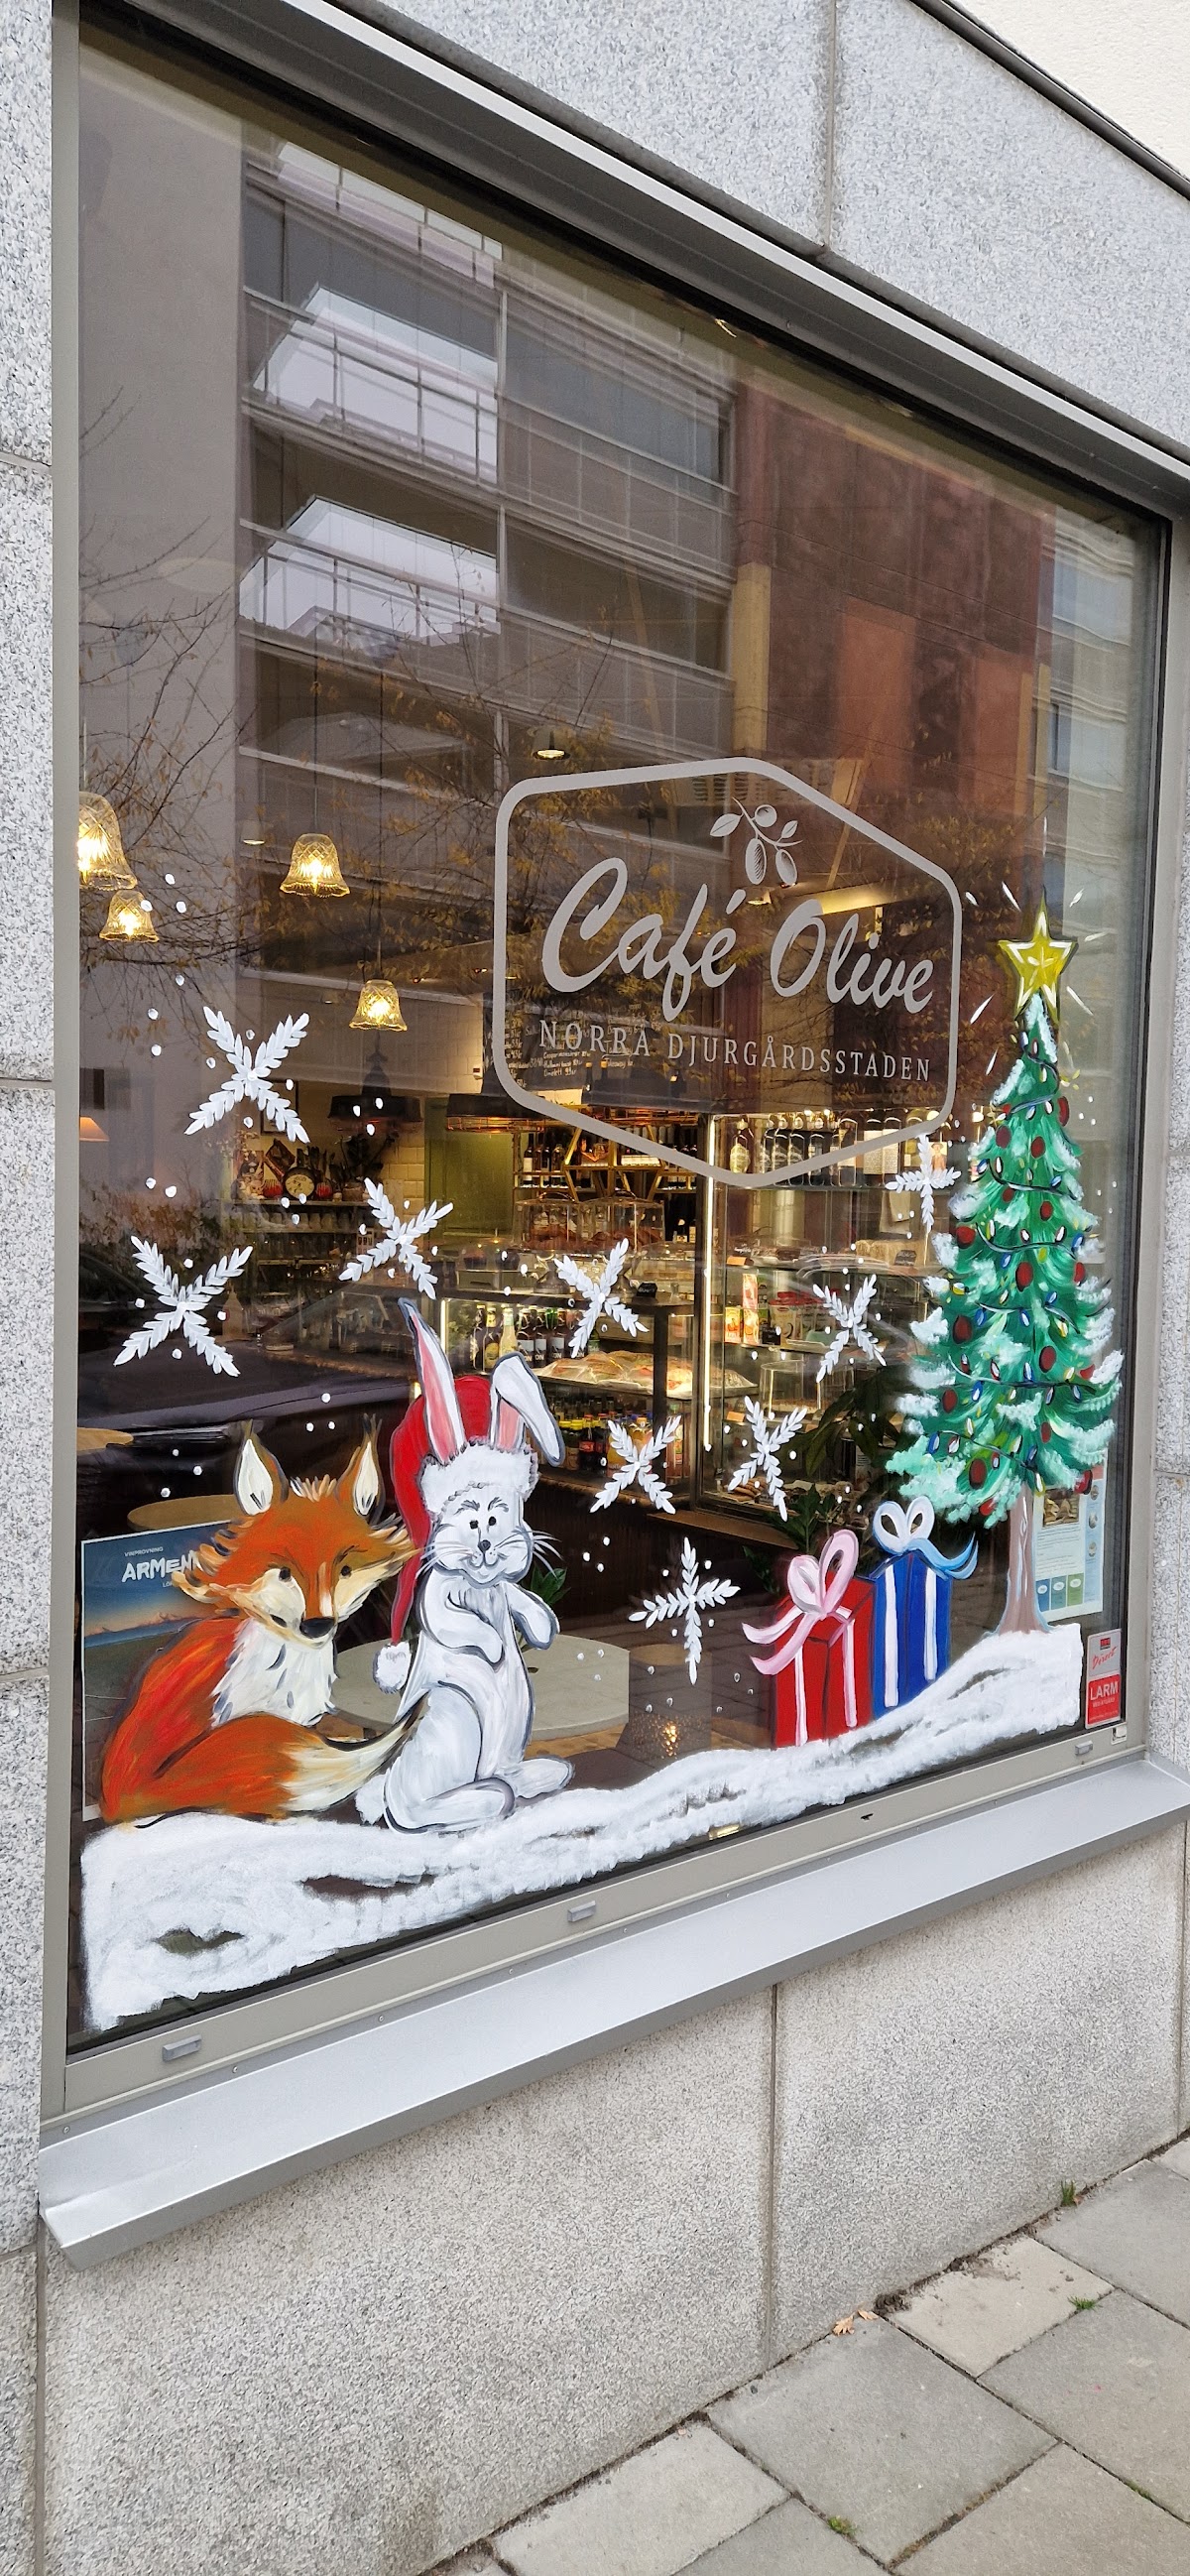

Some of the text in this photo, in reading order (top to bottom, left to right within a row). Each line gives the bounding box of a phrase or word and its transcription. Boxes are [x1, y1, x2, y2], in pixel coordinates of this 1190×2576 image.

[542, 858, 936, 1022] Café Olive
[538, 1019, 652, 1057] NORRA
[667, 1033, 931, 1083] DJURGÅRDSSTADEN
[121, 1549, 199, 1582] ARMEN
[124, 1546, 164, 1557] VINPROVNING
[1090, 1680, 1119, 1700] LARM
